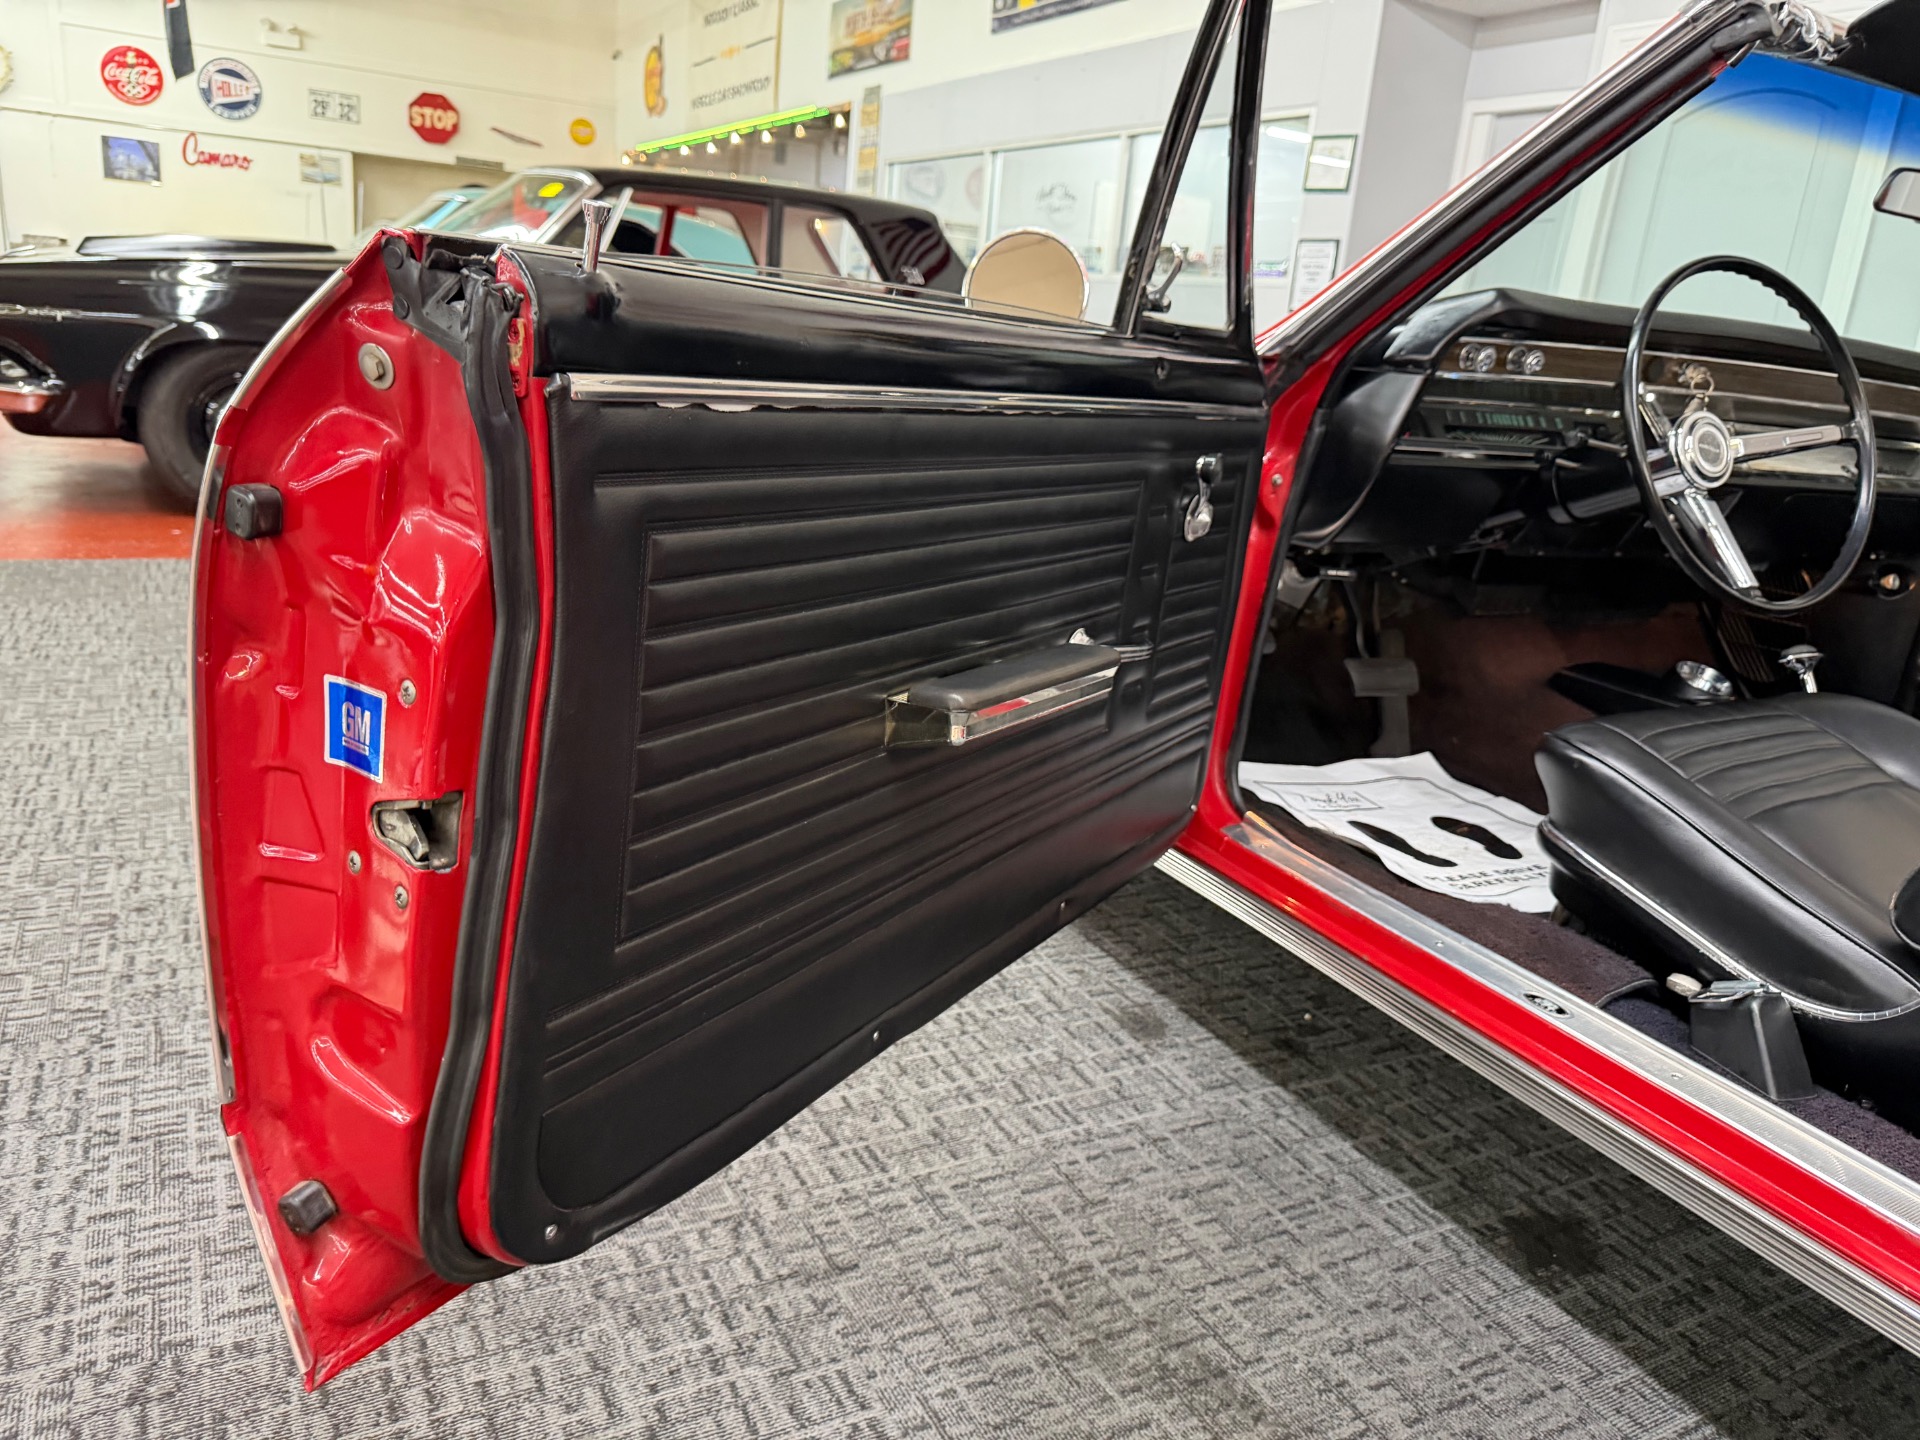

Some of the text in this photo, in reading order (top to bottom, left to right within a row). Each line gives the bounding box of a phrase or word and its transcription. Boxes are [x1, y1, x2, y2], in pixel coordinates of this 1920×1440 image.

[410, 105, 458, 131] STOP
[182, 132, 253, 171] Camaro
[342, 701, 371, 747] GM
[1424, 863, 1548, 882] PLEASE DRIVE
